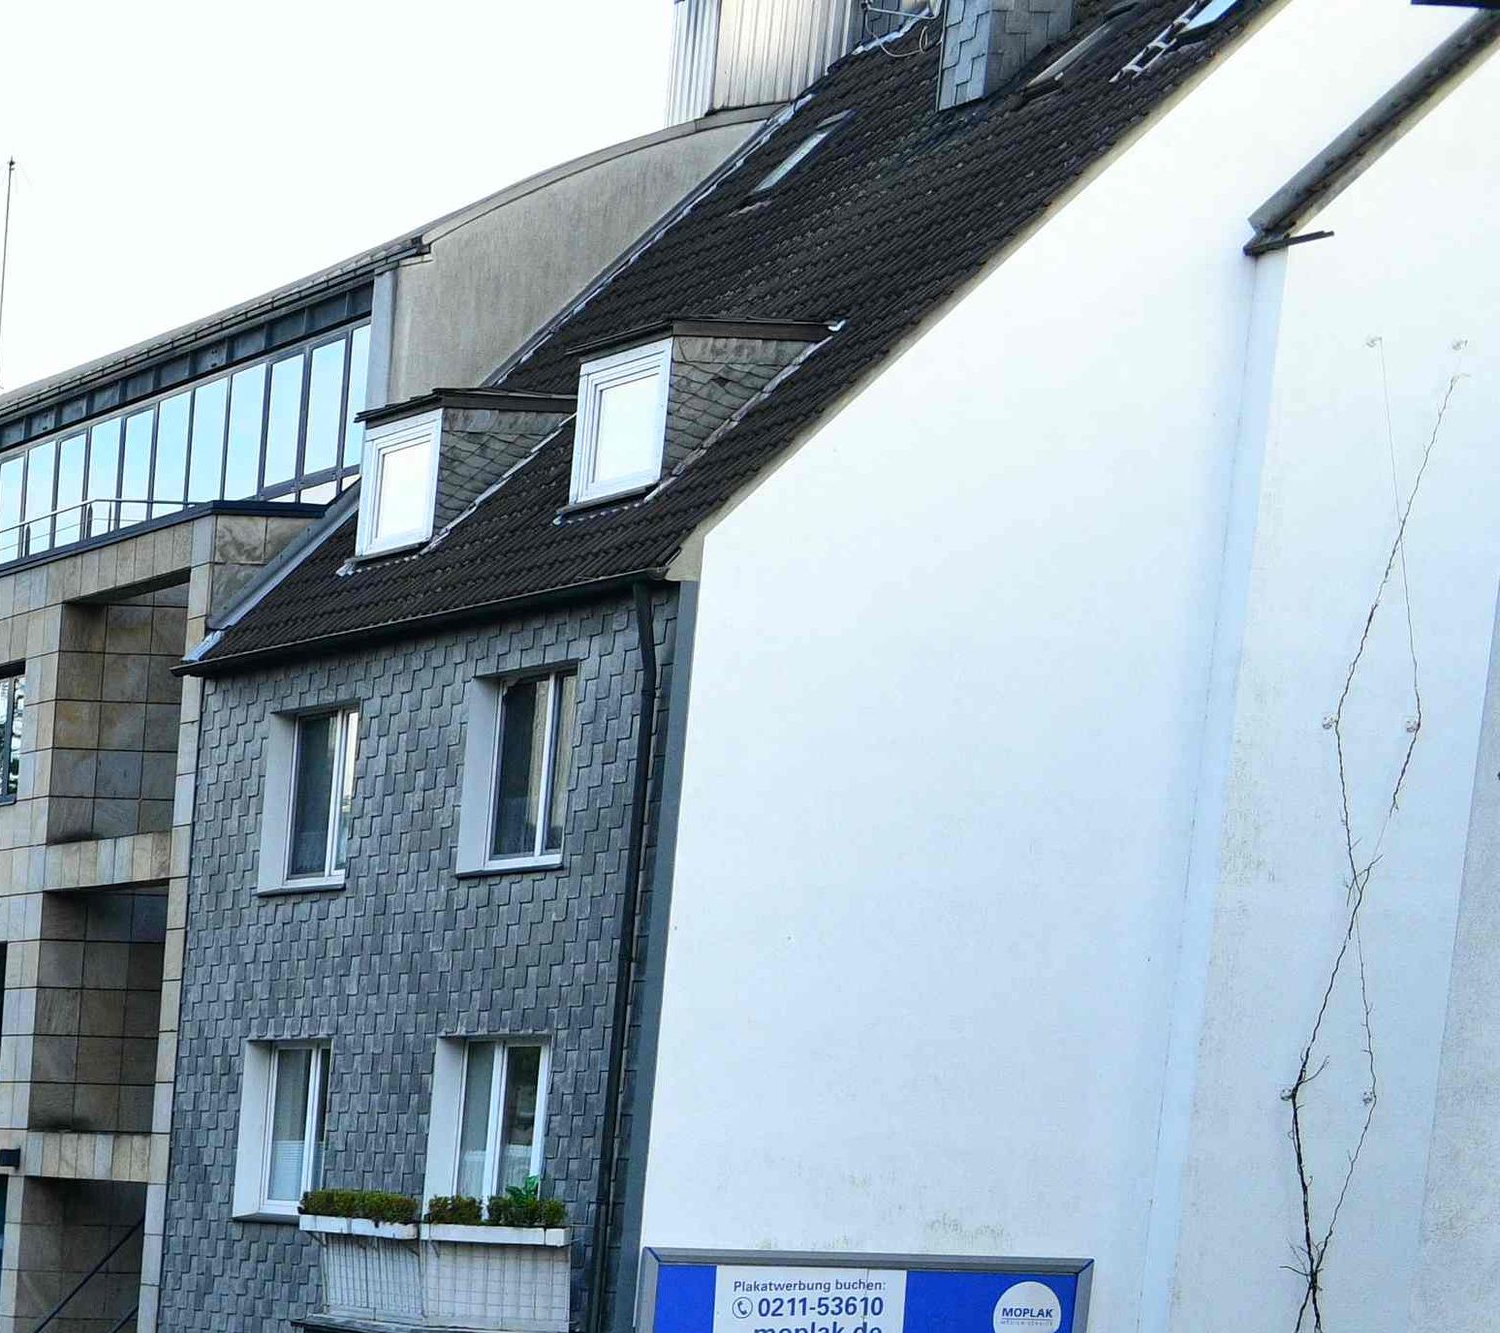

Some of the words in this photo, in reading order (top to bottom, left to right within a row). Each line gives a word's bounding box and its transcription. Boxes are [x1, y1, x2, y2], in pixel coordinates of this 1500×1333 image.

[733, 1280, 833, 1294] Plakatwerbung
[834, 1279, 887, 1292] buchen:
[757, 1295, 884, 1318] 0211-53610
[1001, 1307, 1053, 1319] MOPLAK
